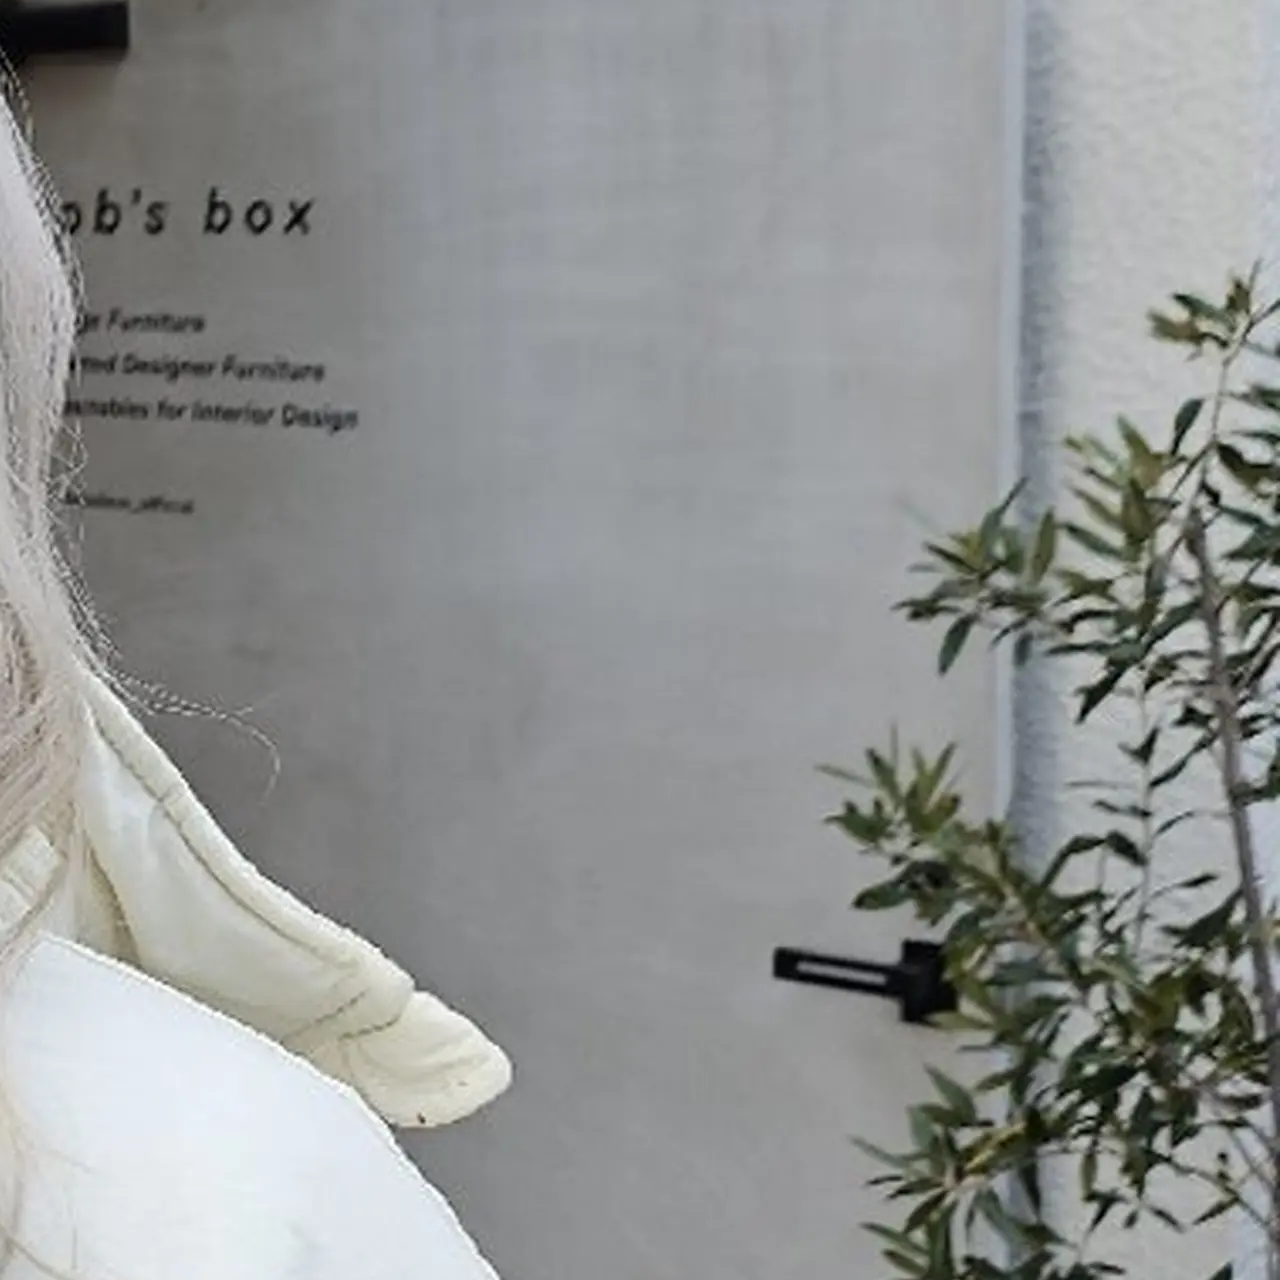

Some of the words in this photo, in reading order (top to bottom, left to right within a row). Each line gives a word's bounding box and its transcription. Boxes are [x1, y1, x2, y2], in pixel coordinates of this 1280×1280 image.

[58, 187, 168, 236] ob's
[203, 186, 316, 237] box
[107, 306, 206, 334] Furniture
[122, 353, 216, 386] Designer
[222, 353, 326, 384] Furniture
[157, 397, 188, 420] for
[191, 398, 275, 427] Interior
[281, 402, 359, 437] Design
